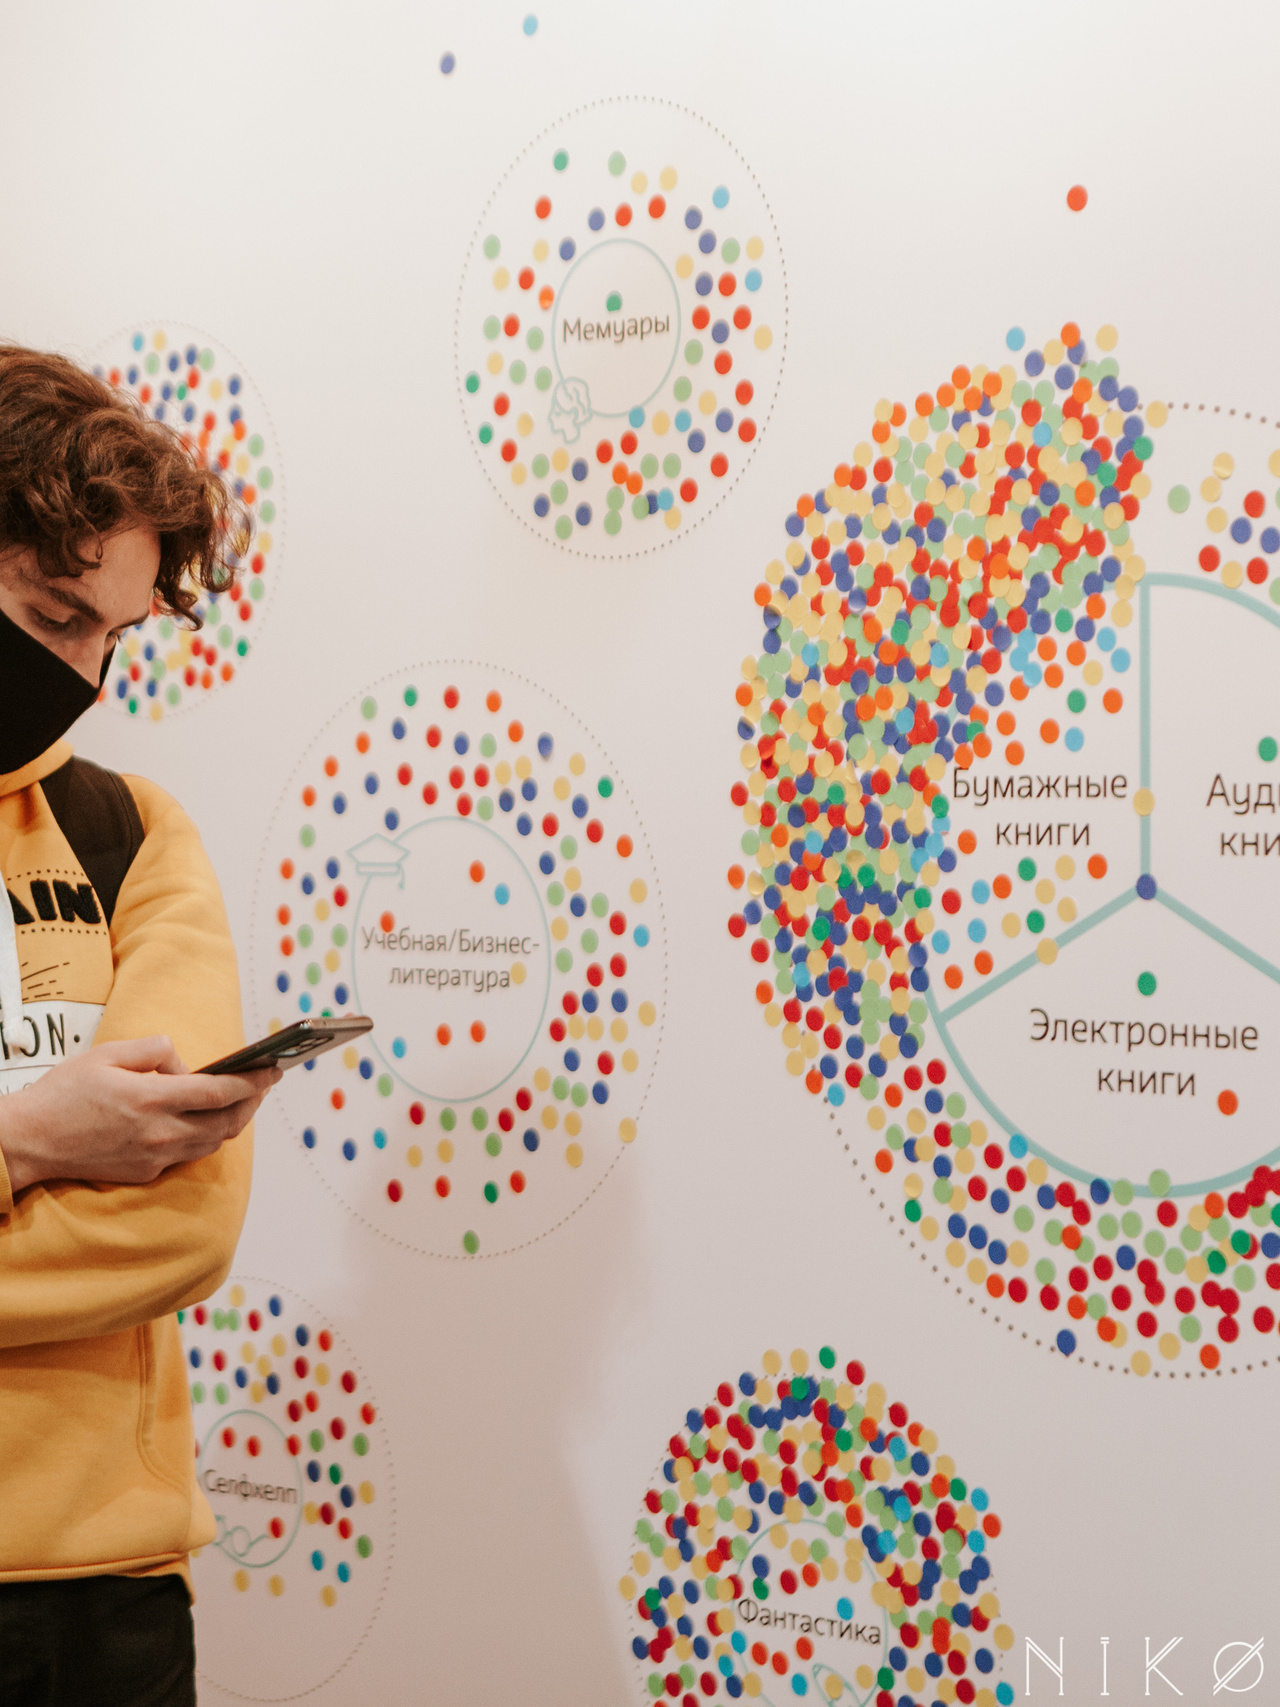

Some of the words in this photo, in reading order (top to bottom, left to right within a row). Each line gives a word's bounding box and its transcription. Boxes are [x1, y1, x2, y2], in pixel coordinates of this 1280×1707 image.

[563, 315, 670, 343] Мемуары
[953, 766, 1128, 806] Бумажные
[1206, 773, 1280, 815] Ауд
[996, 823, 1090, 847] книги
[389, 967, 510, 993] литература
[1030, 1008, 1259, 1051] Электронные
[1098, 1069, 1196, 1096] книги
[738, 1598, 881, 1645] Фантастика
